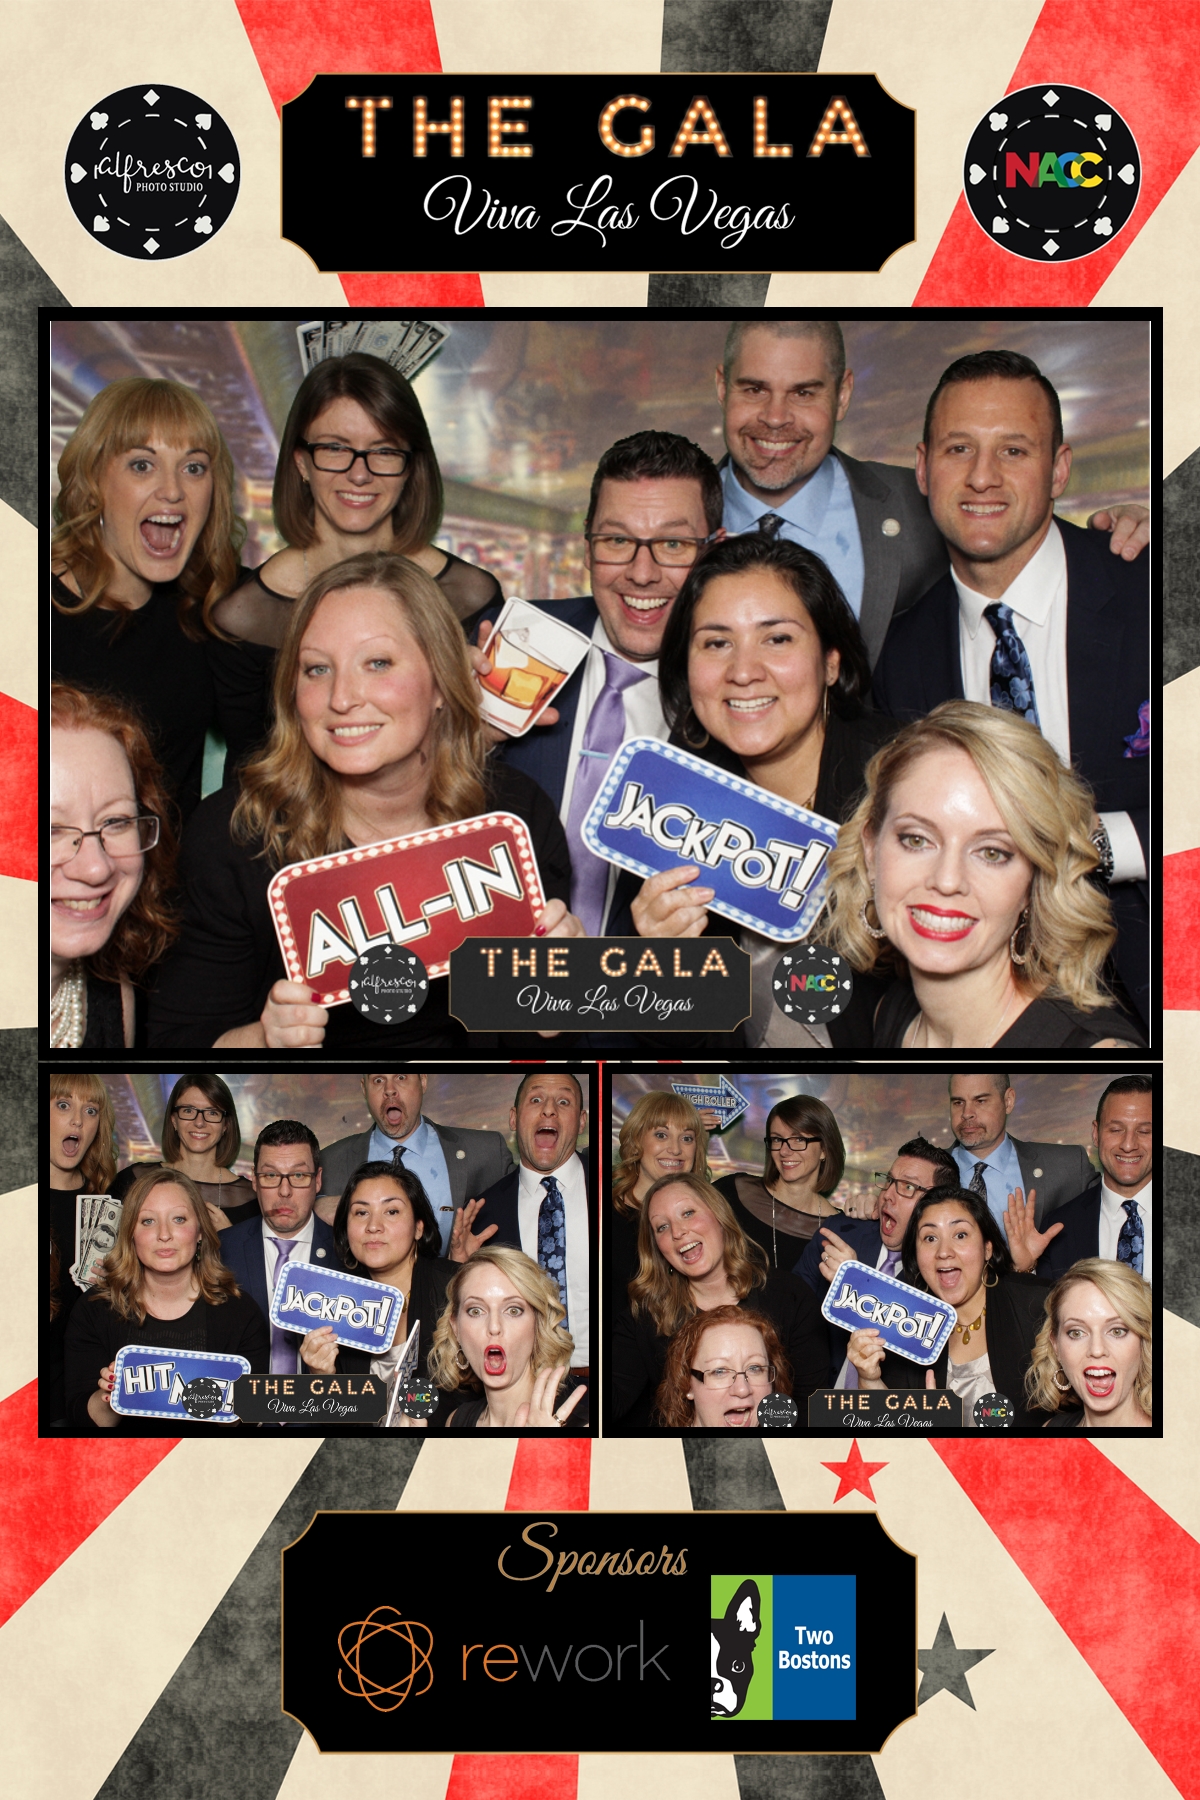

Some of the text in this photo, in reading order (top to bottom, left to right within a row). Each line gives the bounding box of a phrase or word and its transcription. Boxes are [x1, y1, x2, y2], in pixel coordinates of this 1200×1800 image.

[604, 782, 831, 911] JACKPOT!
[307, 842, 524, 978] ALL-IN
[704, 1095, 737, 1108] ROLLER
[280, 1285, 394, 1336] JACKPOT!
[833, 1283, 946, 1349] JACKPOT!
[123, 1362, 175, 1395] HIT
